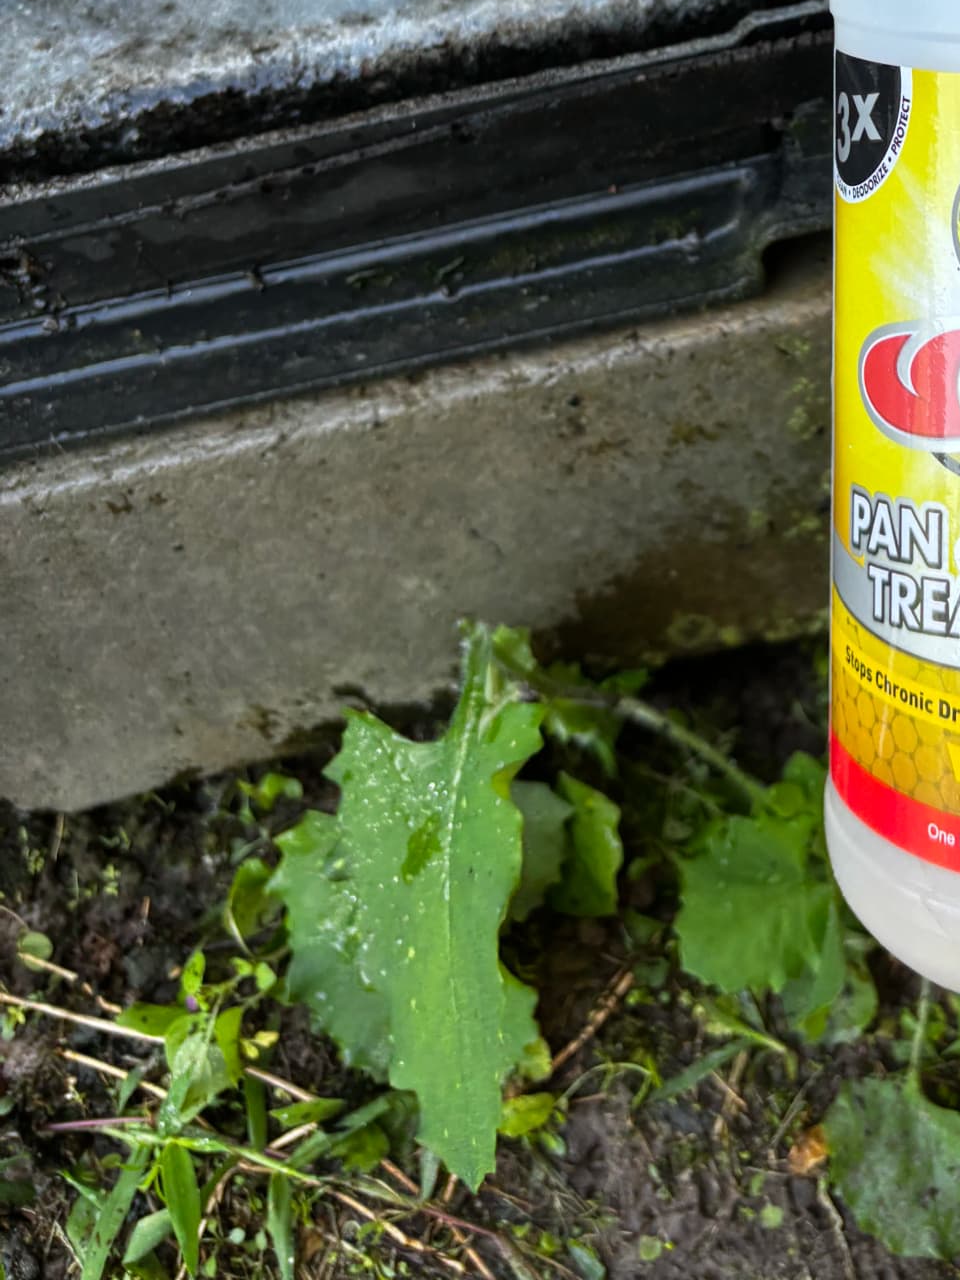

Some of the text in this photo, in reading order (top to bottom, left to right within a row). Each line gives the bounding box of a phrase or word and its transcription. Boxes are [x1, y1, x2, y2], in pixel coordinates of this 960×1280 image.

[837, 91, 882, 163] 3X
[853, 96, 911, 199] DEODORIZE PROTECT
[851, 488, 943, 568] PAN
[845, 645, 873, 683] Stops
[875, 670, 934, 714] Chronic
[928, 823, 956, 846] One
